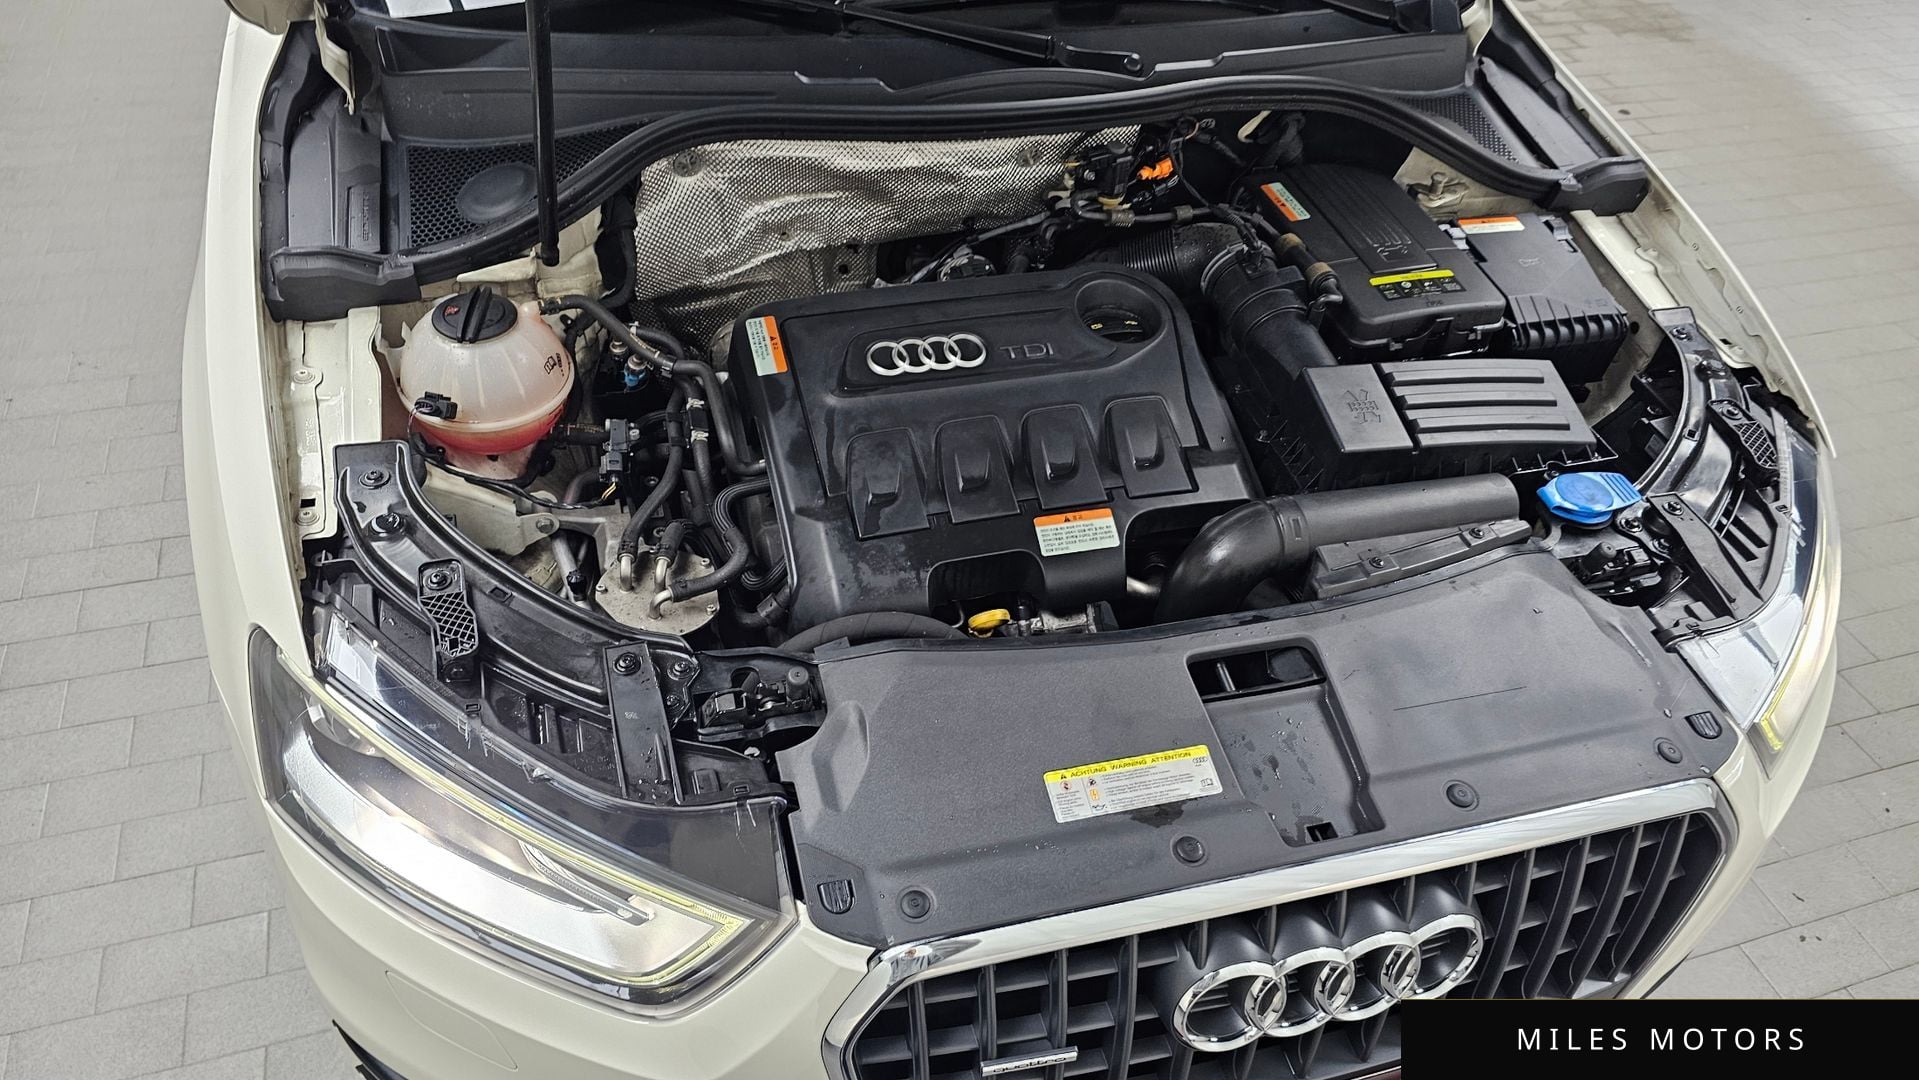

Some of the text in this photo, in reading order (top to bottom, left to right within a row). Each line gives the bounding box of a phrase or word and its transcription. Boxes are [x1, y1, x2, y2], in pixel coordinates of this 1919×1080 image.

[999, 342, 1054, 359] TDI
[1070, 752, 1192, 777] ACHTUNG WARNING ATTENTION
